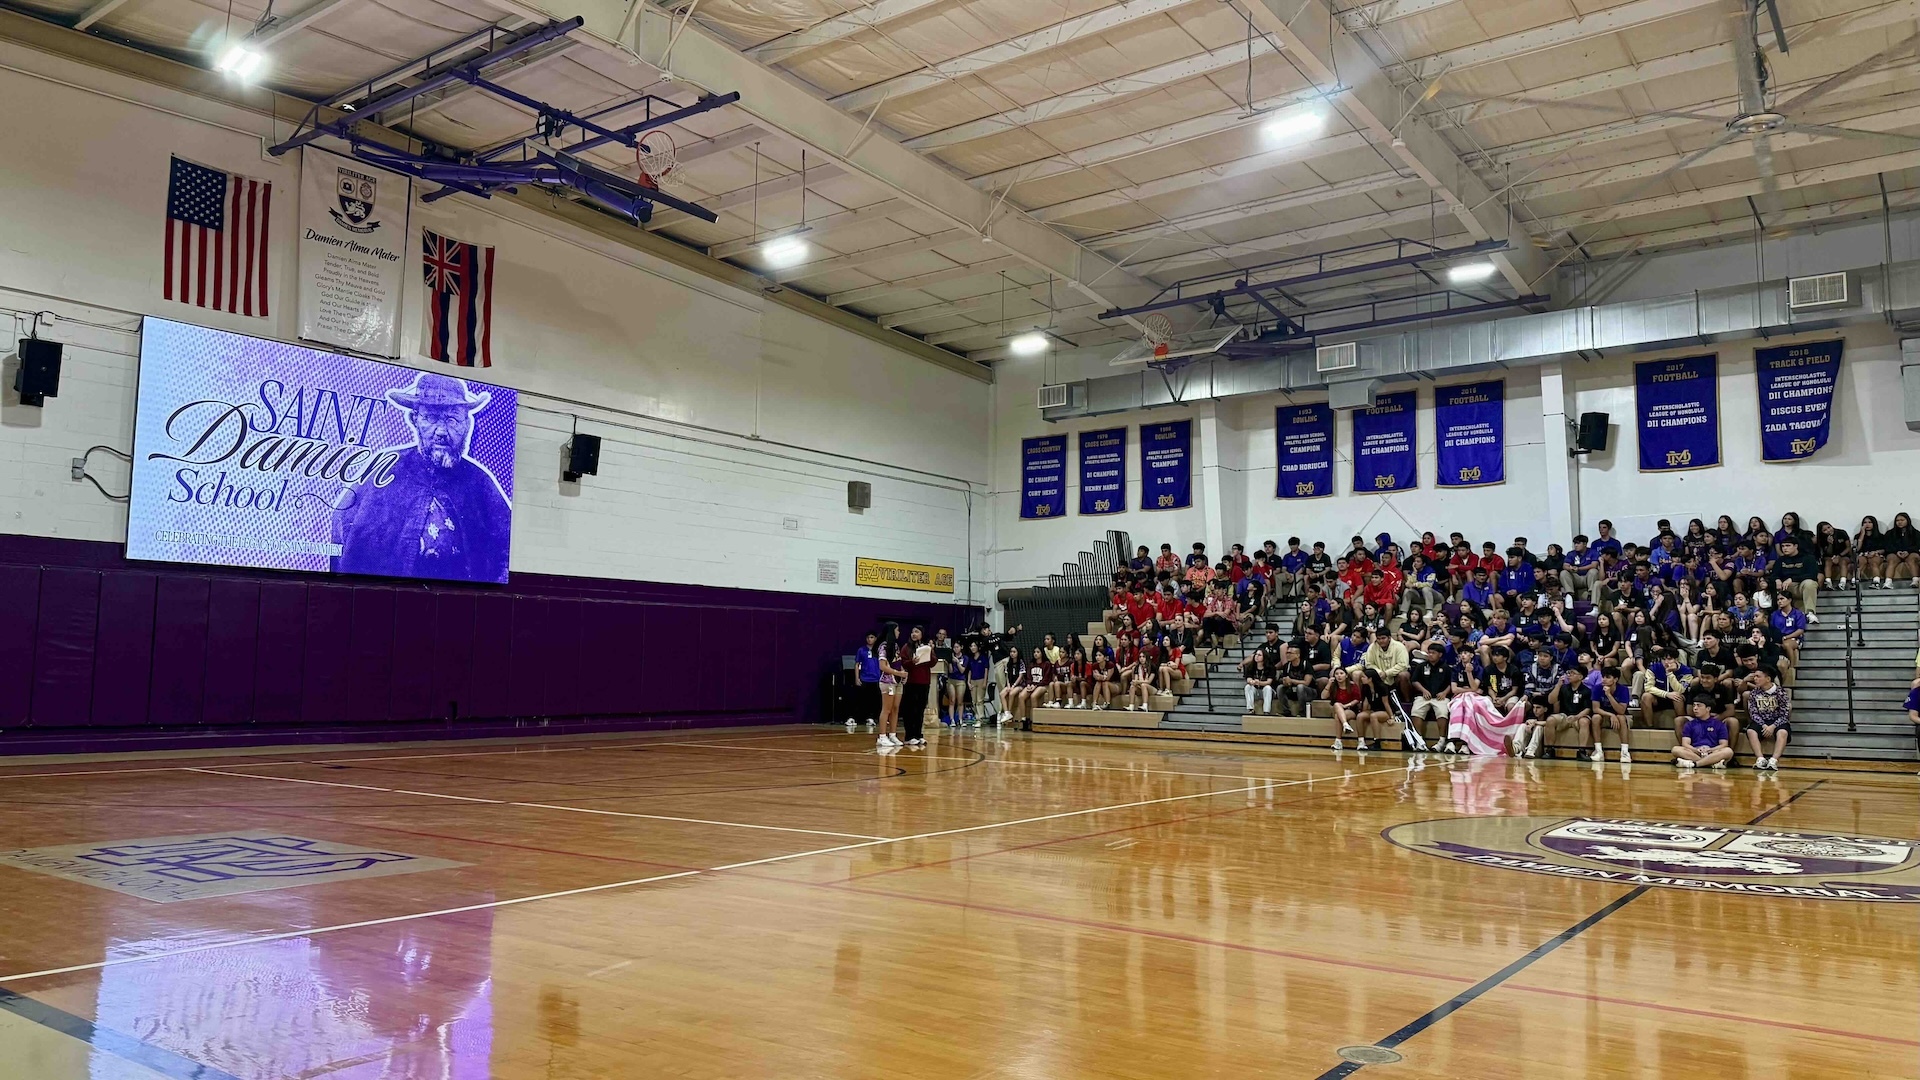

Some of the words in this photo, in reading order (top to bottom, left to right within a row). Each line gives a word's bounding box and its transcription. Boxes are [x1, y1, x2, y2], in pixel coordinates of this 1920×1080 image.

[303, 228, 343, 247] Damien
[344, 240, 369, 255] Alma
[371, 247, 400, 261] Mater
[328, 253, 347, 262] Damien
[324, 260, 342, 269] Tender,
[344, 264, 356, 273] True,
[315, 274, 334, 282] Gleams
[346, 281, 362, 289] Mauve
[323, 267, 342, 278] Proudly
[359, 277, 379, 286] Heavens
[317, 282, 334, 291] Glory's
[343, 304, 359, 313] Hearts
[1769, 359, 1796, 368] TRACK
[1806, 355, 1830, 364] FIELD
[1652, 371, 1698, 382] FOOTBALL
[1775, 372, 1826, 382] INTERSCHOLASTIC
[1802, 378, 1832, 386] HONOLULU
[1449, 395, 1489, 405] FOOTBALL
[1769, 392, 1781, 400] DII
[1366, 405, 1403, 415] FOOTBALL
[1653, 402, 1700, 411] INTERSCHOLASTIC
[1771, 405, 1802, 415] DISCUS
[249, 379, 388, 447] SAINT
[1293, 415, 1317, 423] BOWLING
[1661, 416, 1707, 427] CHAMPIONS
[1449, 423, 1489, 431] INTERSCHOLASTIC
[1765, 423, 1787, 432] ZADA
[1366, 432, 1403, 440] INTERSCHOLASTIC
[1456, 436, 1495, 446] CHAMPIONS
[148, 400, 398, 486] Damien
[1290, 445, 1320, 453] CHAMPION
[1371, 445, 1409, 454] CHAMPIONS
[1299, 461, 1328, 470] HORIUCHI
[167, 468, 289, 512] School
[155, 530, 218, 546] CELEBRATING
[880, 567, 930, 584] VIRILITER
[935, 573, 953, 586] AGE
[1465, 855, 1620, 878] DAMIEN
[1628, 874, 1901, 899] MEMORIAL
